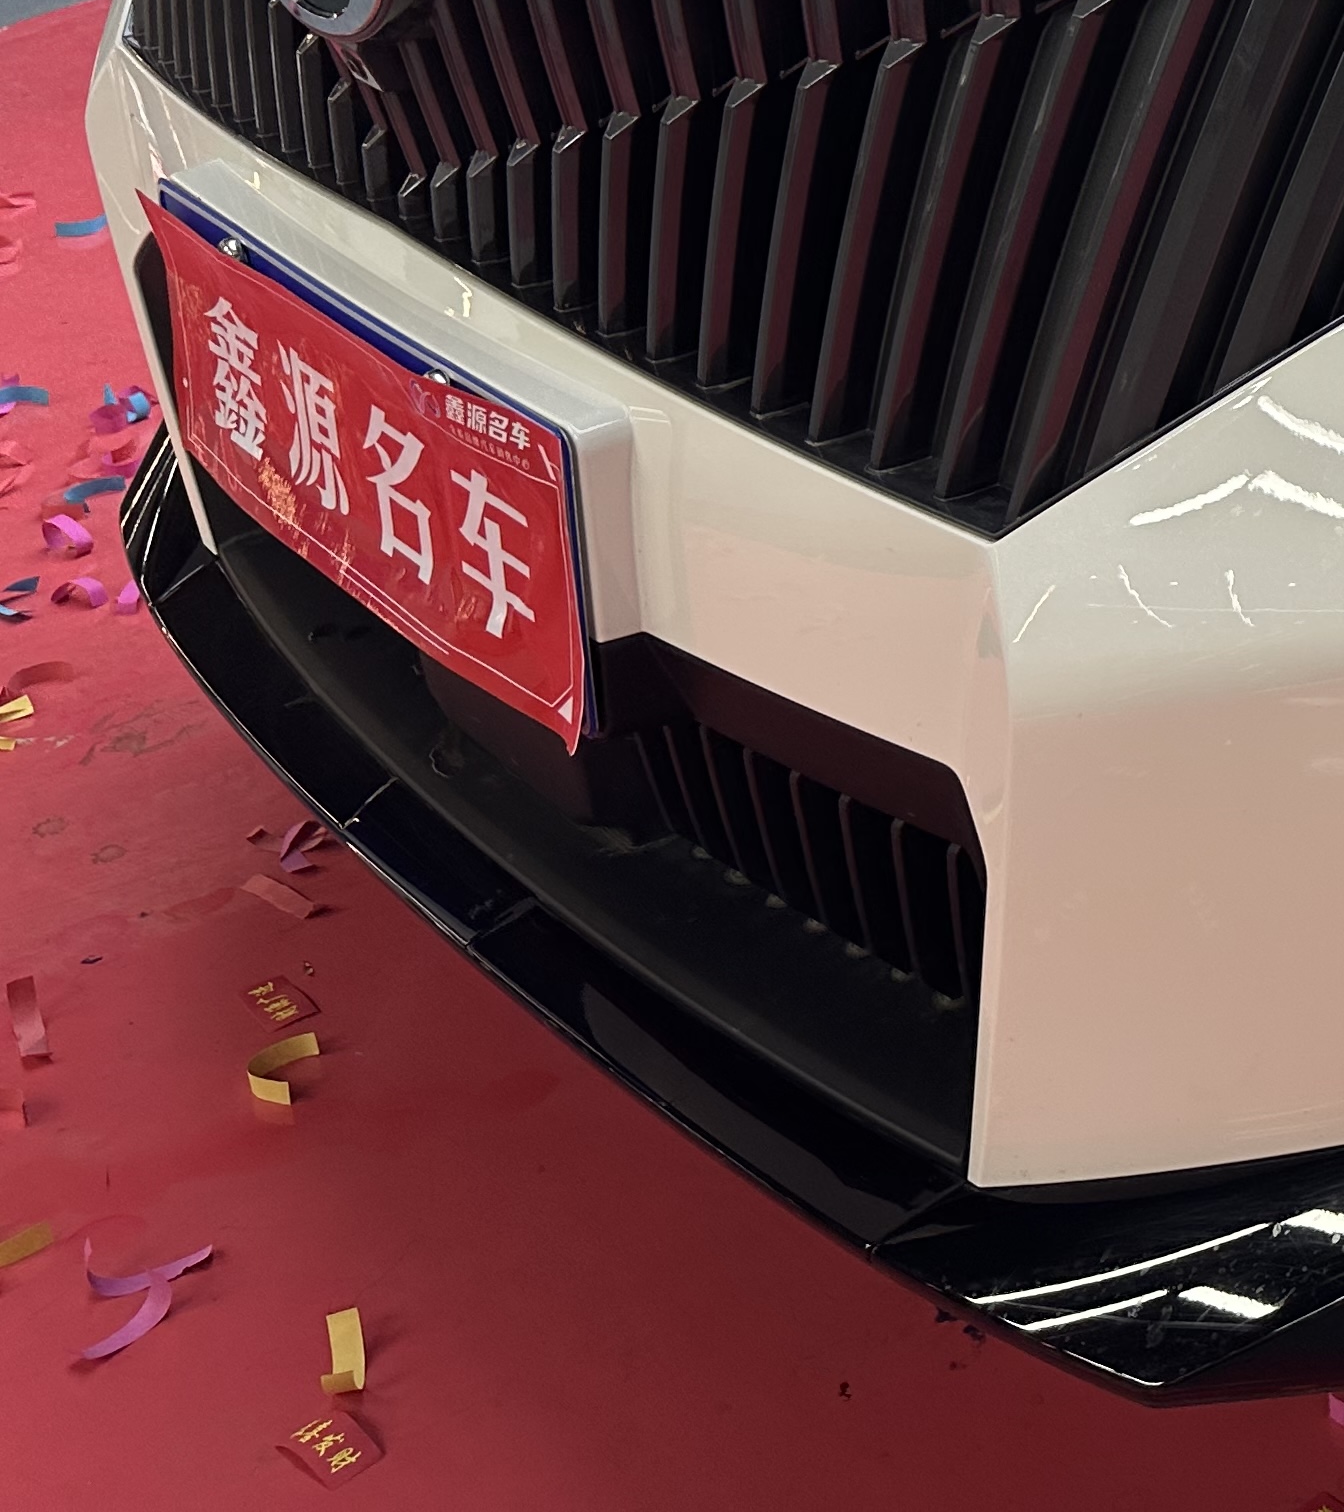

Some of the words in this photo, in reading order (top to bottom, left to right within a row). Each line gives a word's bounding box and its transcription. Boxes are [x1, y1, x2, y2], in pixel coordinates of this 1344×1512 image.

[204, 297, 536, 639] 鑫源名车
[444, 393, 531, 451] 鑫源名车
